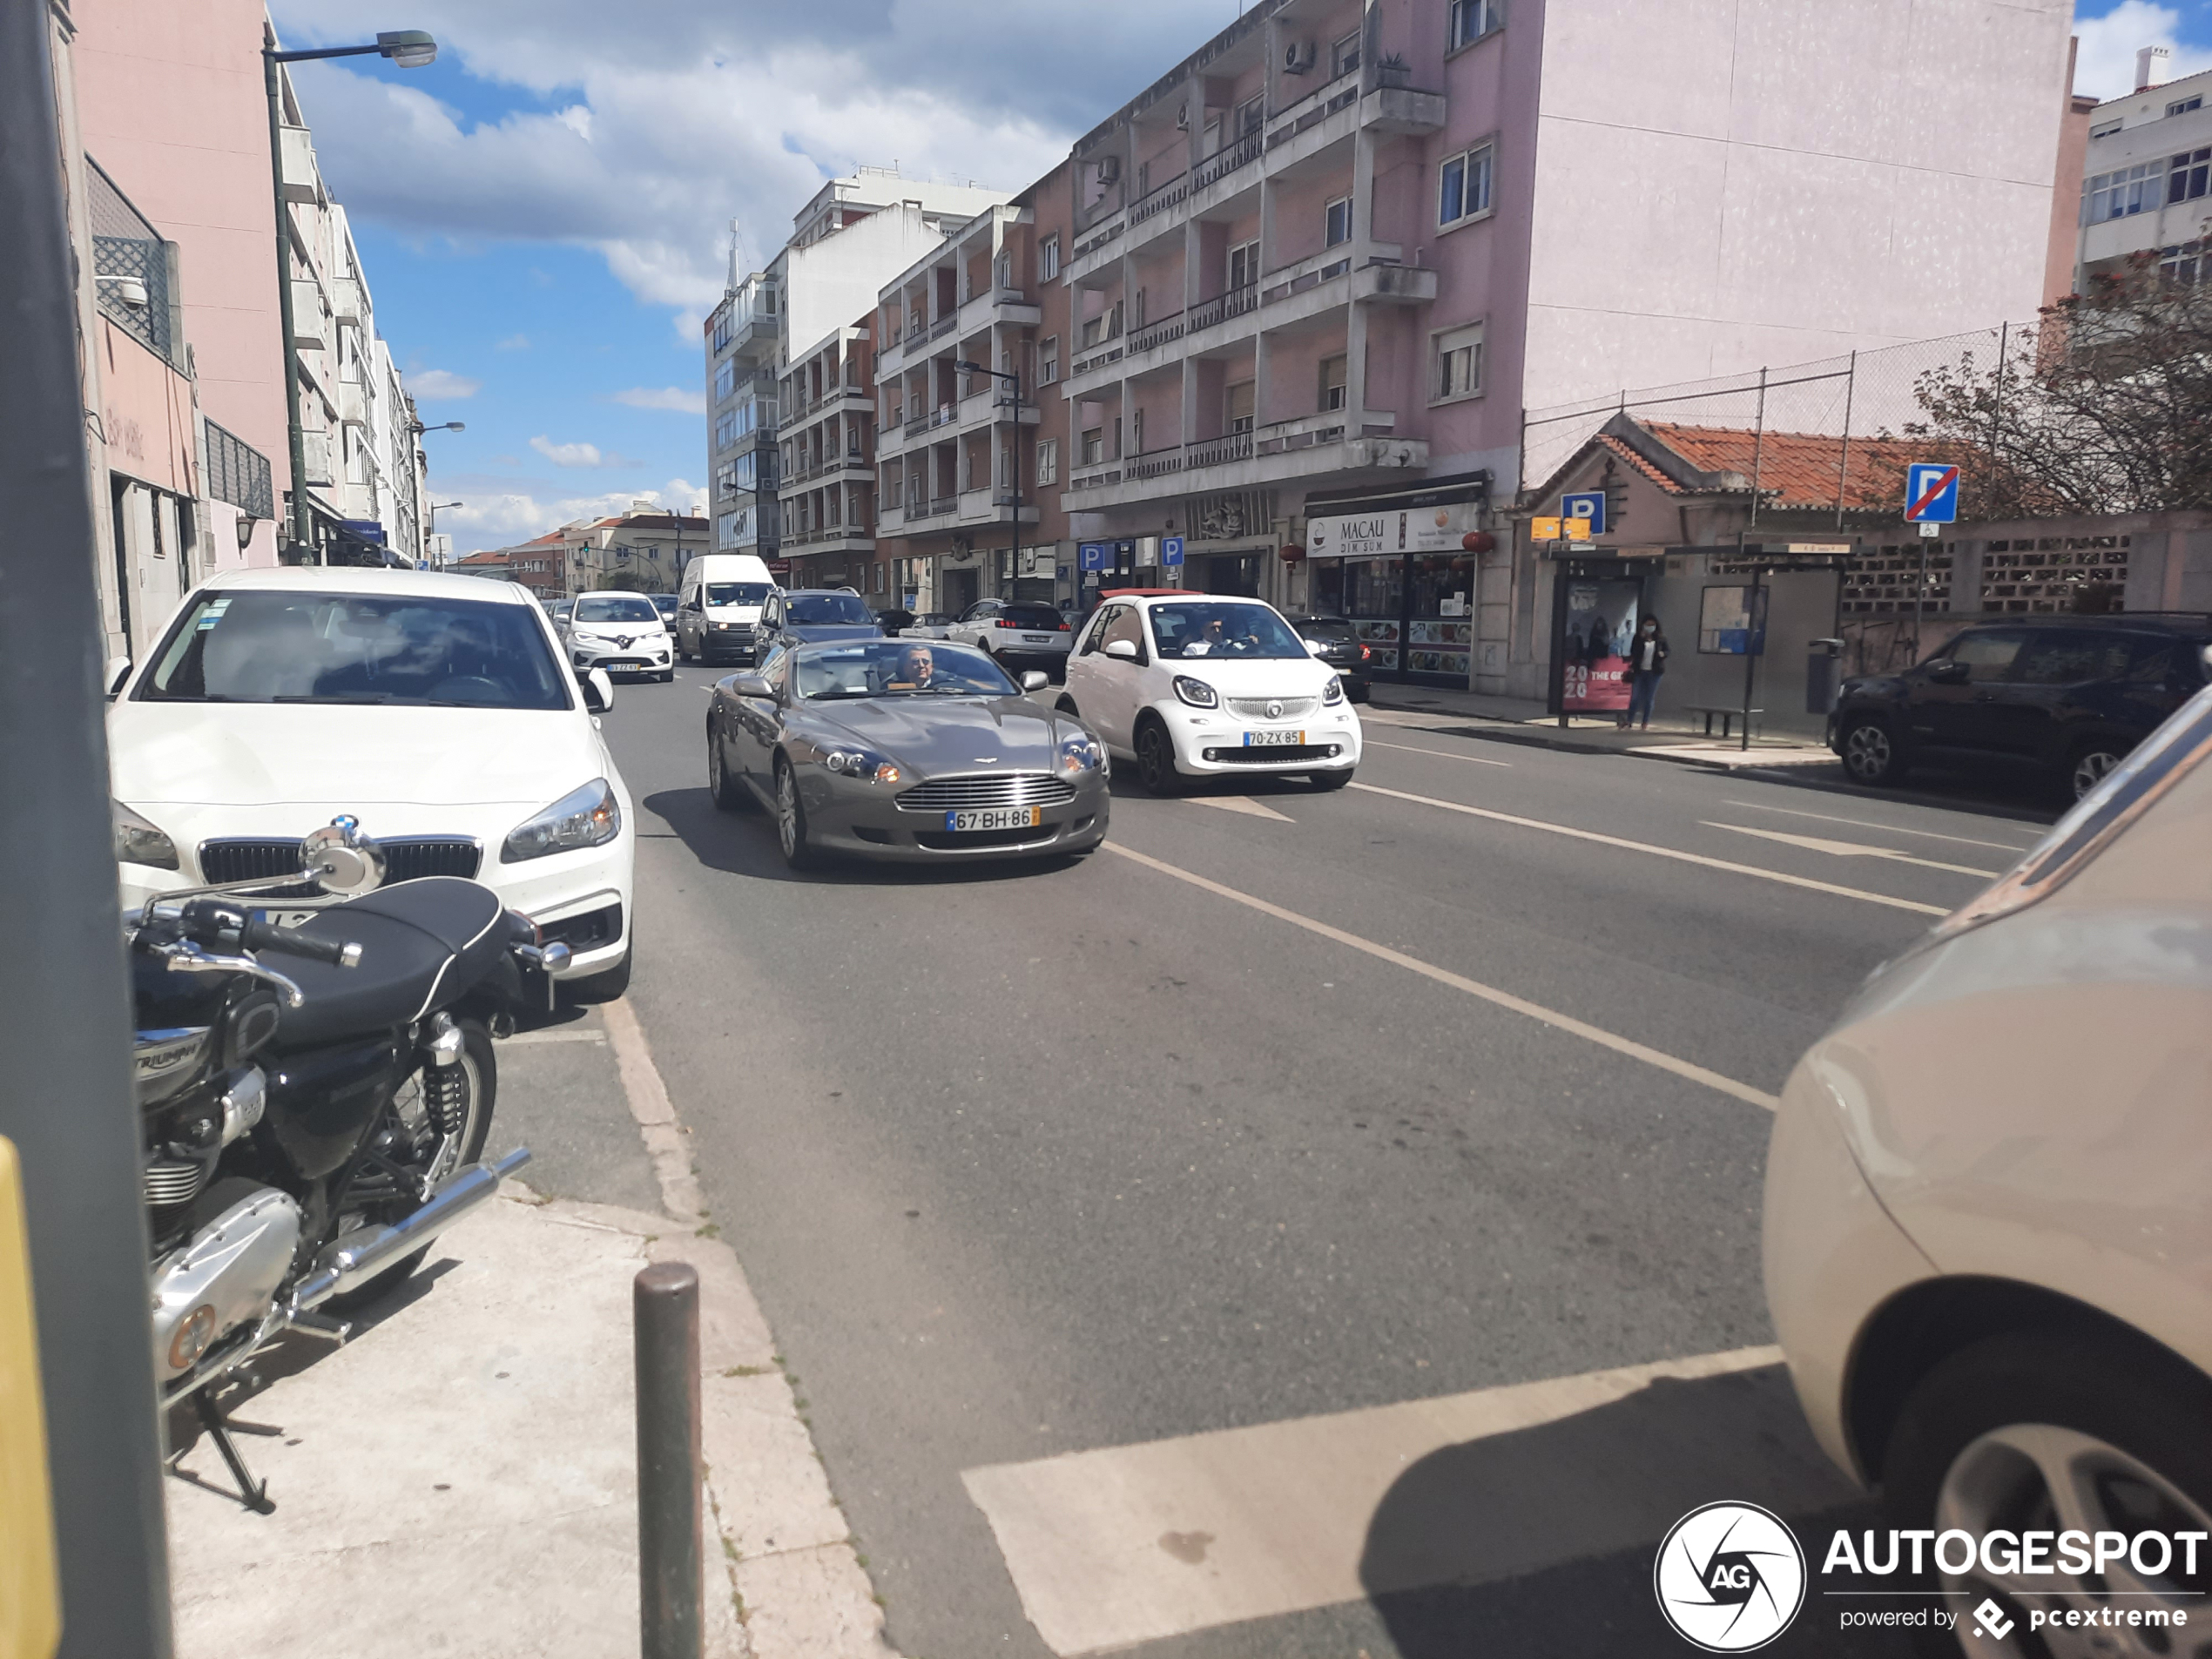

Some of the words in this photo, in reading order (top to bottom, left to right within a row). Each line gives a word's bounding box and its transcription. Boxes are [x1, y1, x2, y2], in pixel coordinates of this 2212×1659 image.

[1340, 520, 1385, 540] MACAU
[1166, 540, 1179, 564] P
[1341, 543, 1358, 553] DIM
[1364, 542, 1383, 552] SUM
[1085, 548, 1099, 569] P
[1566, 665, 1588, 682] 20
[1591, 671, 1608, 681] THE
[1564, 682, 1587, 698] 20
